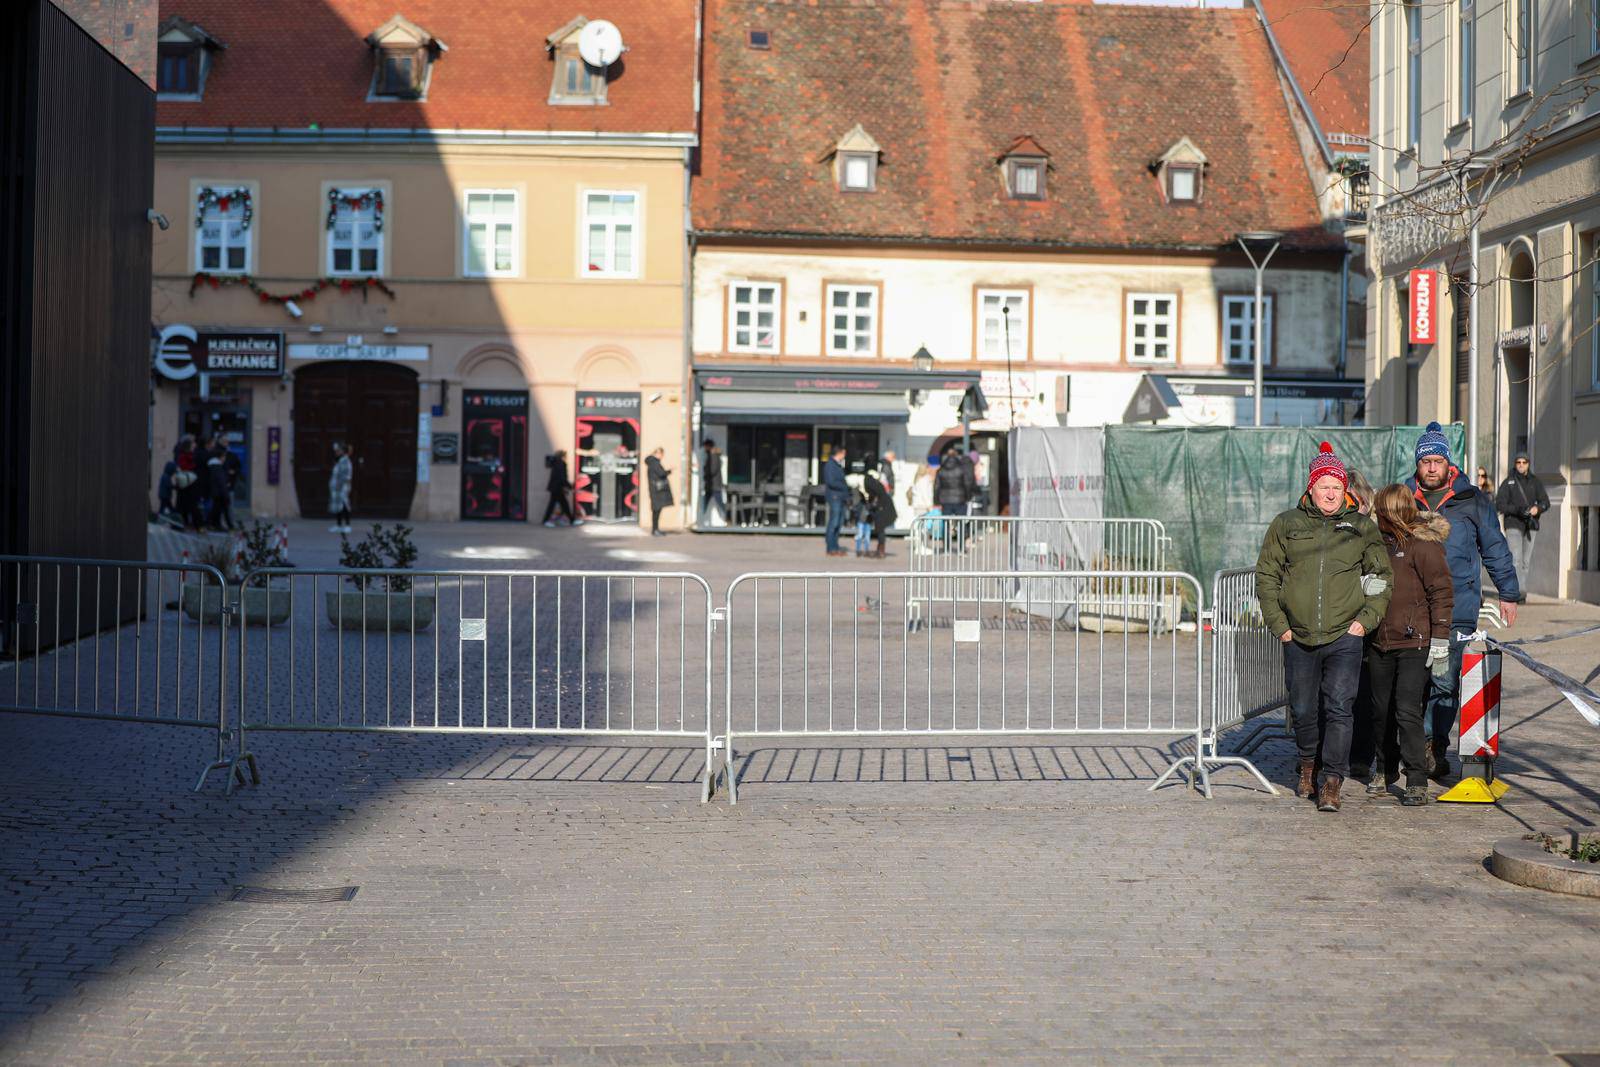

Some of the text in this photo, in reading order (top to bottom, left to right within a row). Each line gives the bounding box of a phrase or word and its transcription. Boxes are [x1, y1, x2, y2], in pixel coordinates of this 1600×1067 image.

[1416, 273, 1430, 339] KONZUM
[207, 354, 277, 369] EXCHANGE
[483, 396, 526, 406] TISSOT
[596, 397, 639, 408] TISSOT
